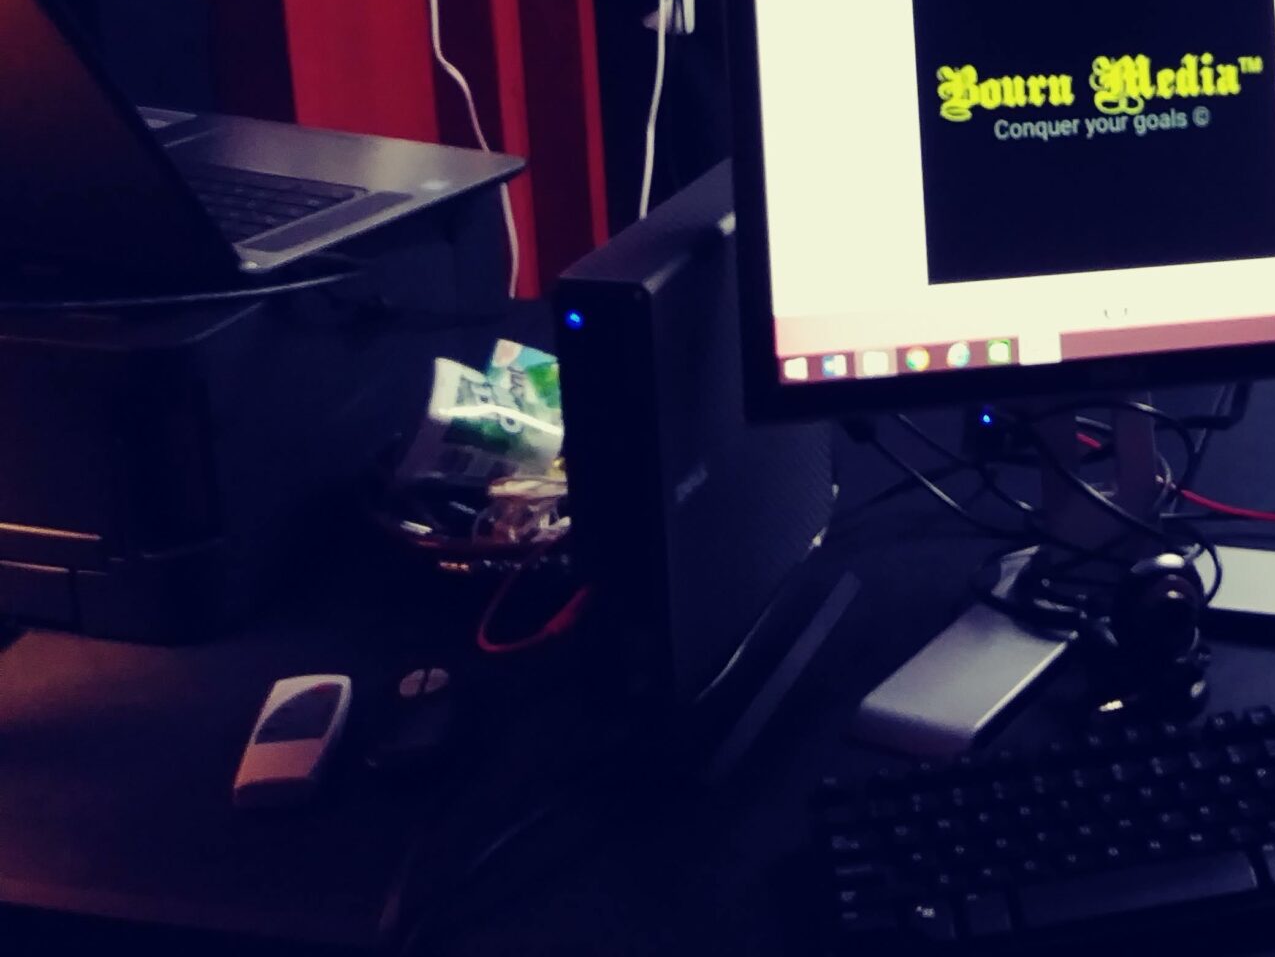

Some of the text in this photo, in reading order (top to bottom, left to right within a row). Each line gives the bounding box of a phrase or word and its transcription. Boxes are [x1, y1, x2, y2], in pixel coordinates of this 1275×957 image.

[994, 115, 1079, 142] Conquer
[1085, 112, 1128, 140] your
[1134, 107, 1188, 136] goals
